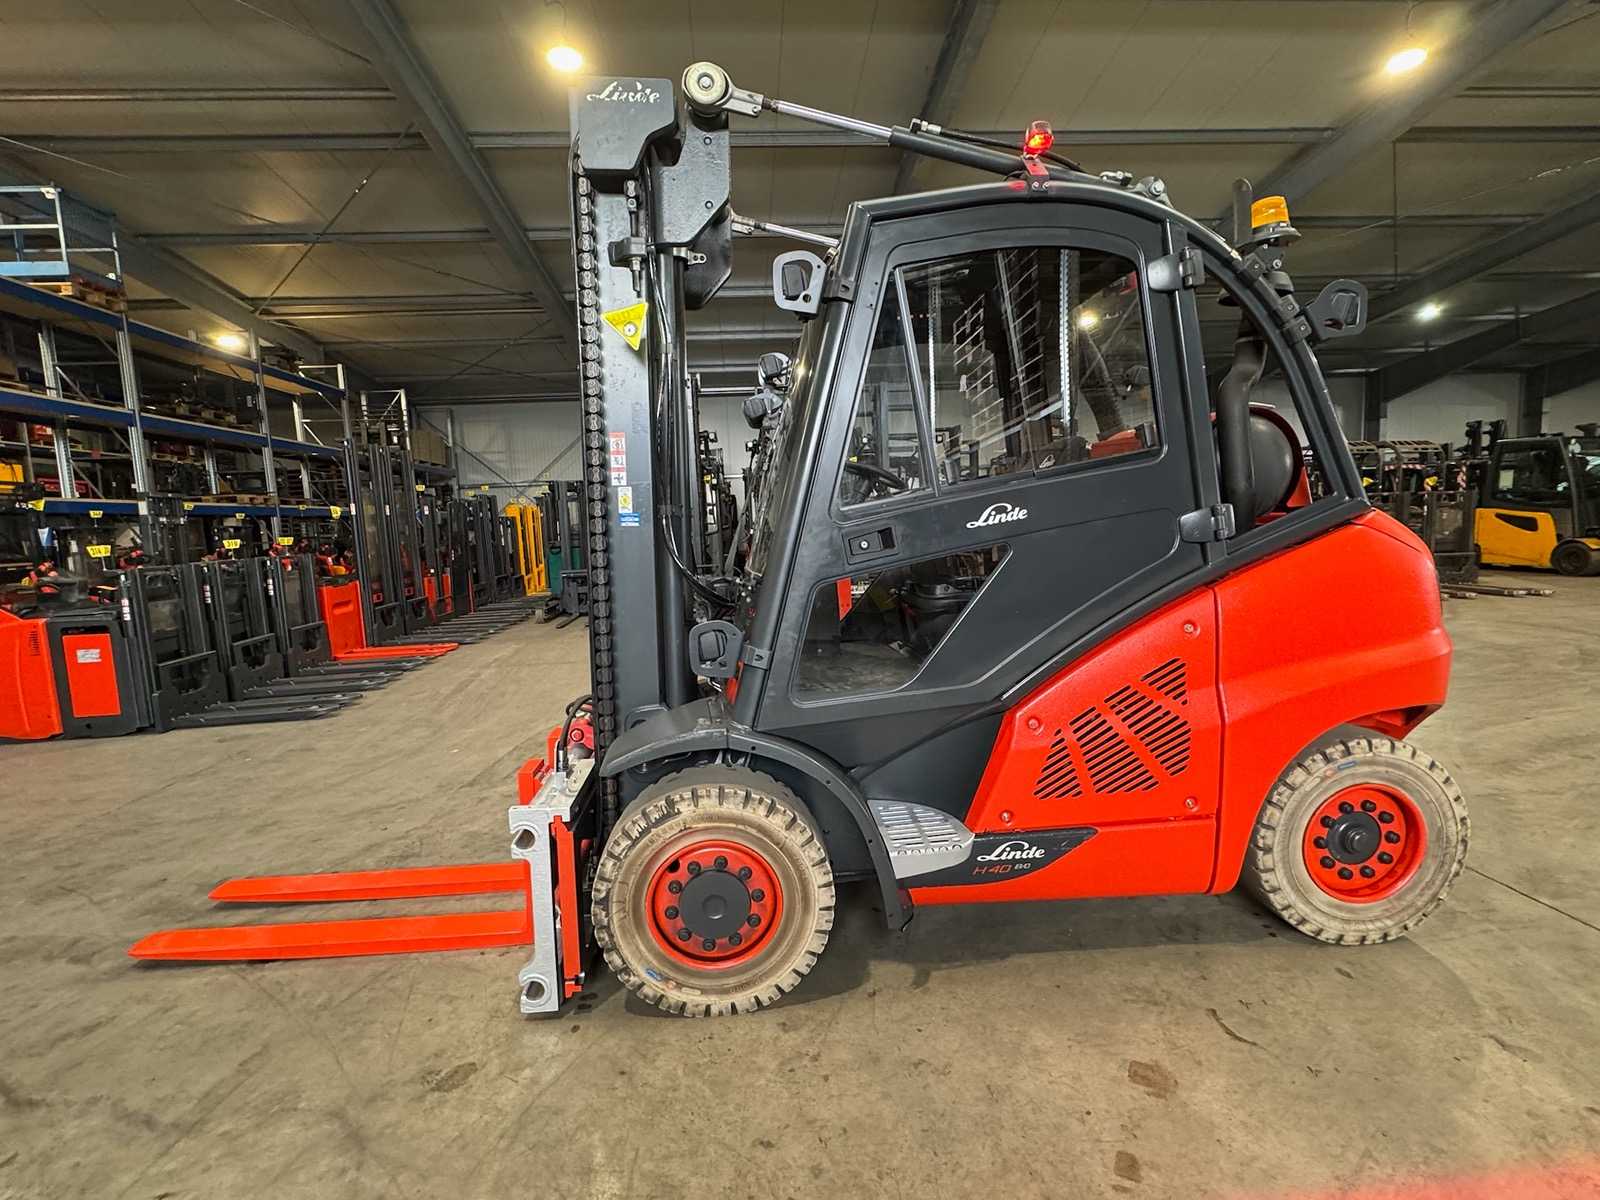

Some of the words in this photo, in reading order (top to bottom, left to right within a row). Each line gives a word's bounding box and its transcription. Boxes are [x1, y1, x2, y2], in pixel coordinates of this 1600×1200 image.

[586, 80, 660, 103] Linde
[966, 503, 1028, 528] Linde
[977, 840, 1046, 862] Linde
